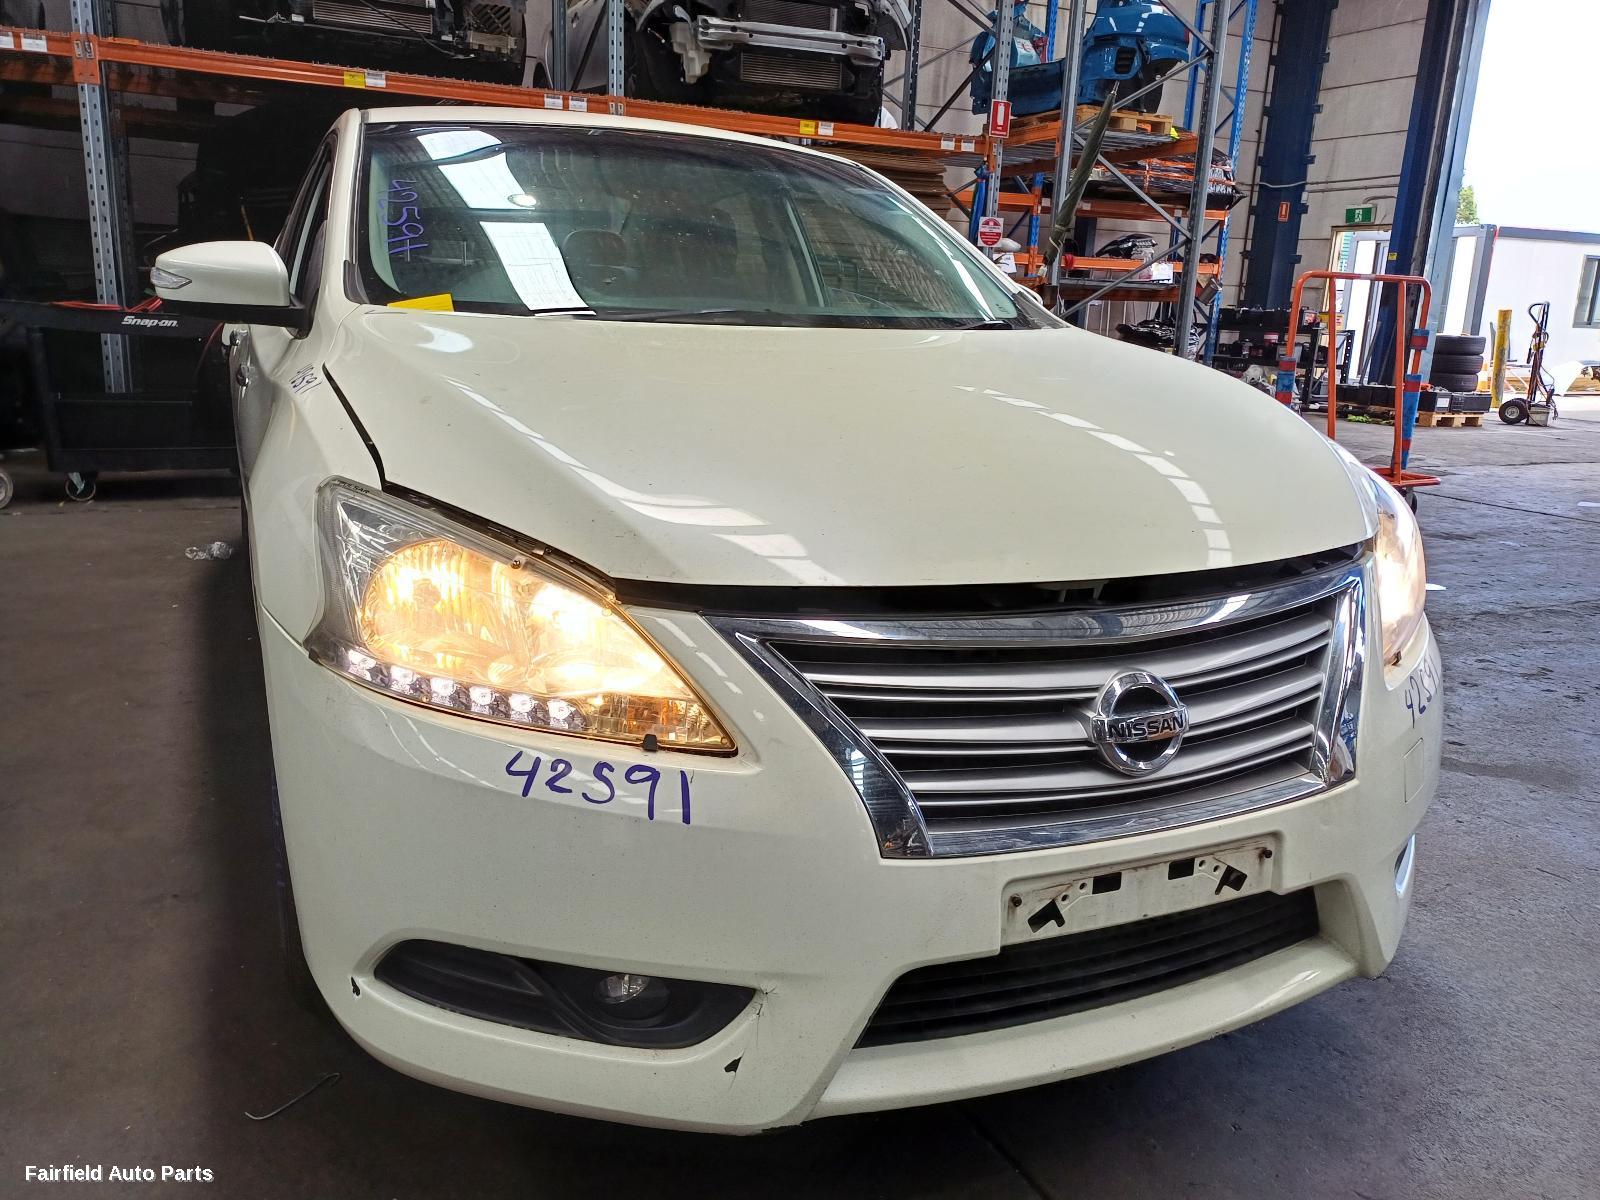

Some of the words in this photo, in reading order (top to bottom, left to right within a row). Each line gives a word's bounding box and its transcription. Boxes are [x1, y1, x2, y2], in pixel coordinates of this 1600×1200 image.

[121, 315, 178, 328] Snap-on
[1108, 714, 1184, 738] NISSAN
[505, 750, 691, 825] 42591
